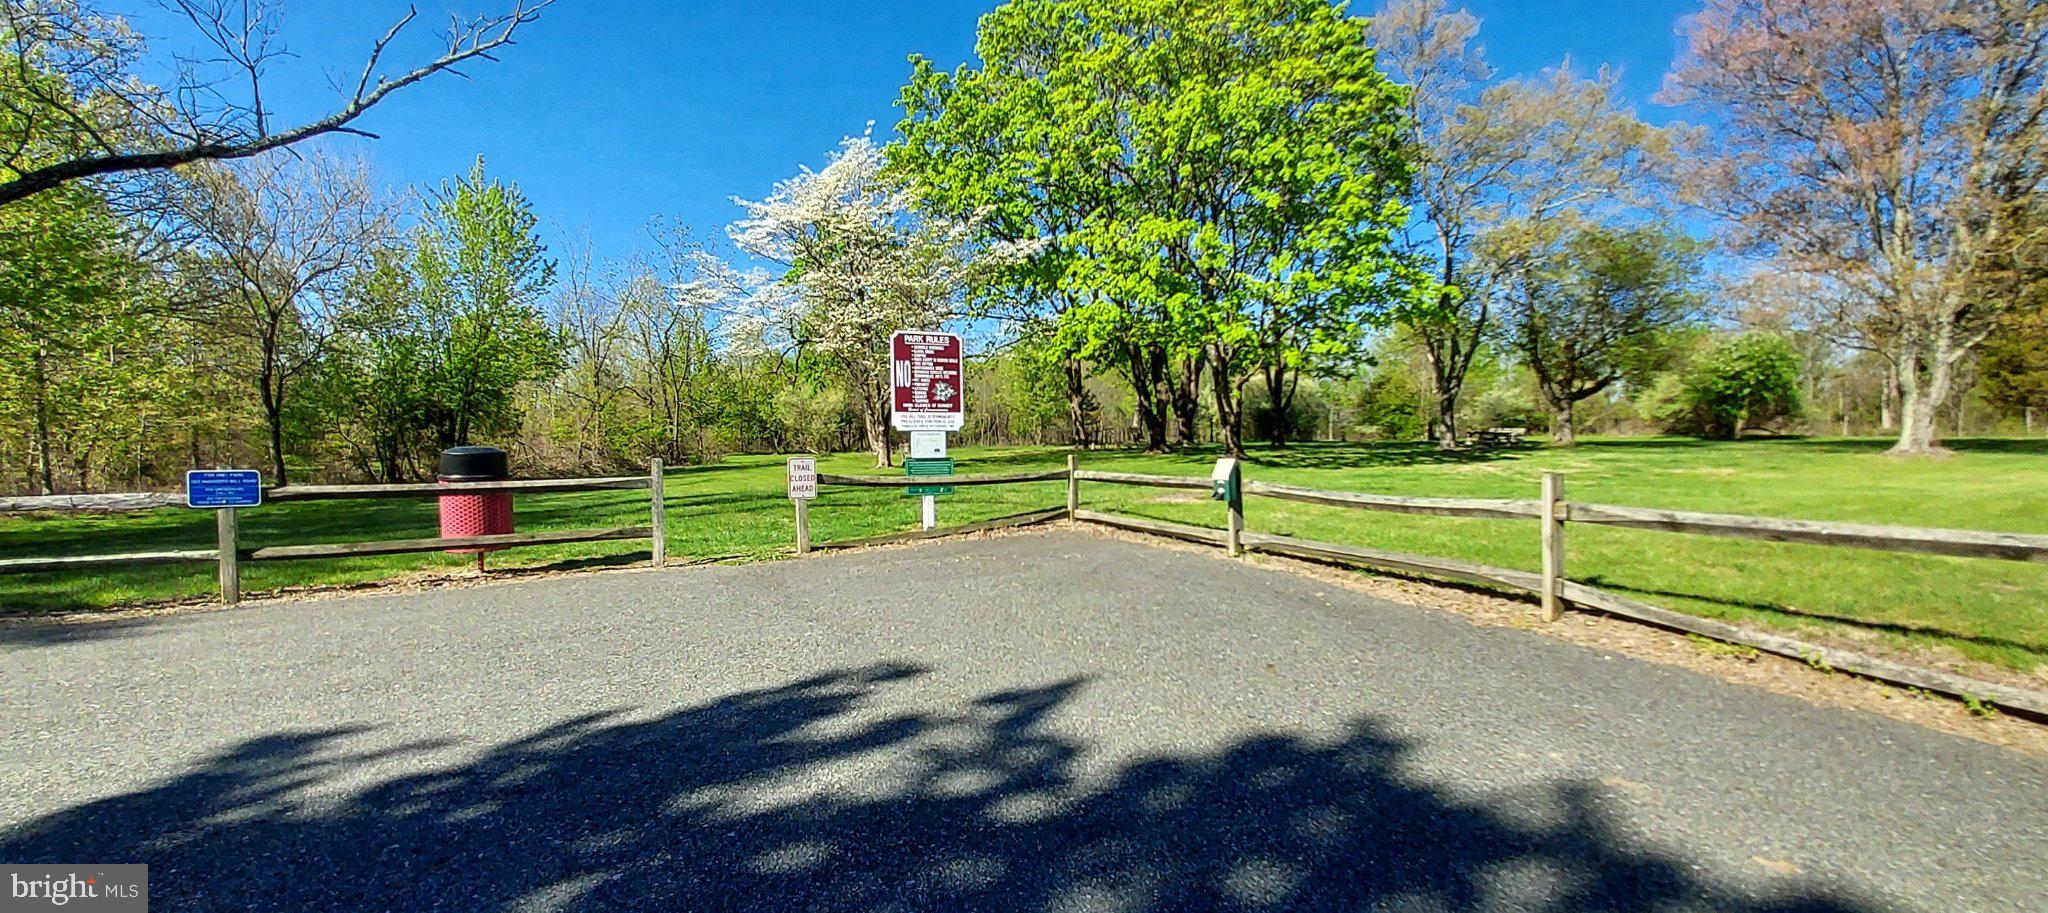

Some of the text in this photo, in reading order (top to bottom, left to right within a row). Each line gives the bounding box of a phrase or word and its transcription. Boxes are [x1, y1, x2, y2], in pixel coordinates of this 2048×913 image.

[904, 334, 950, 344] PARK RULES
[896, 360, 912, 388] NO
